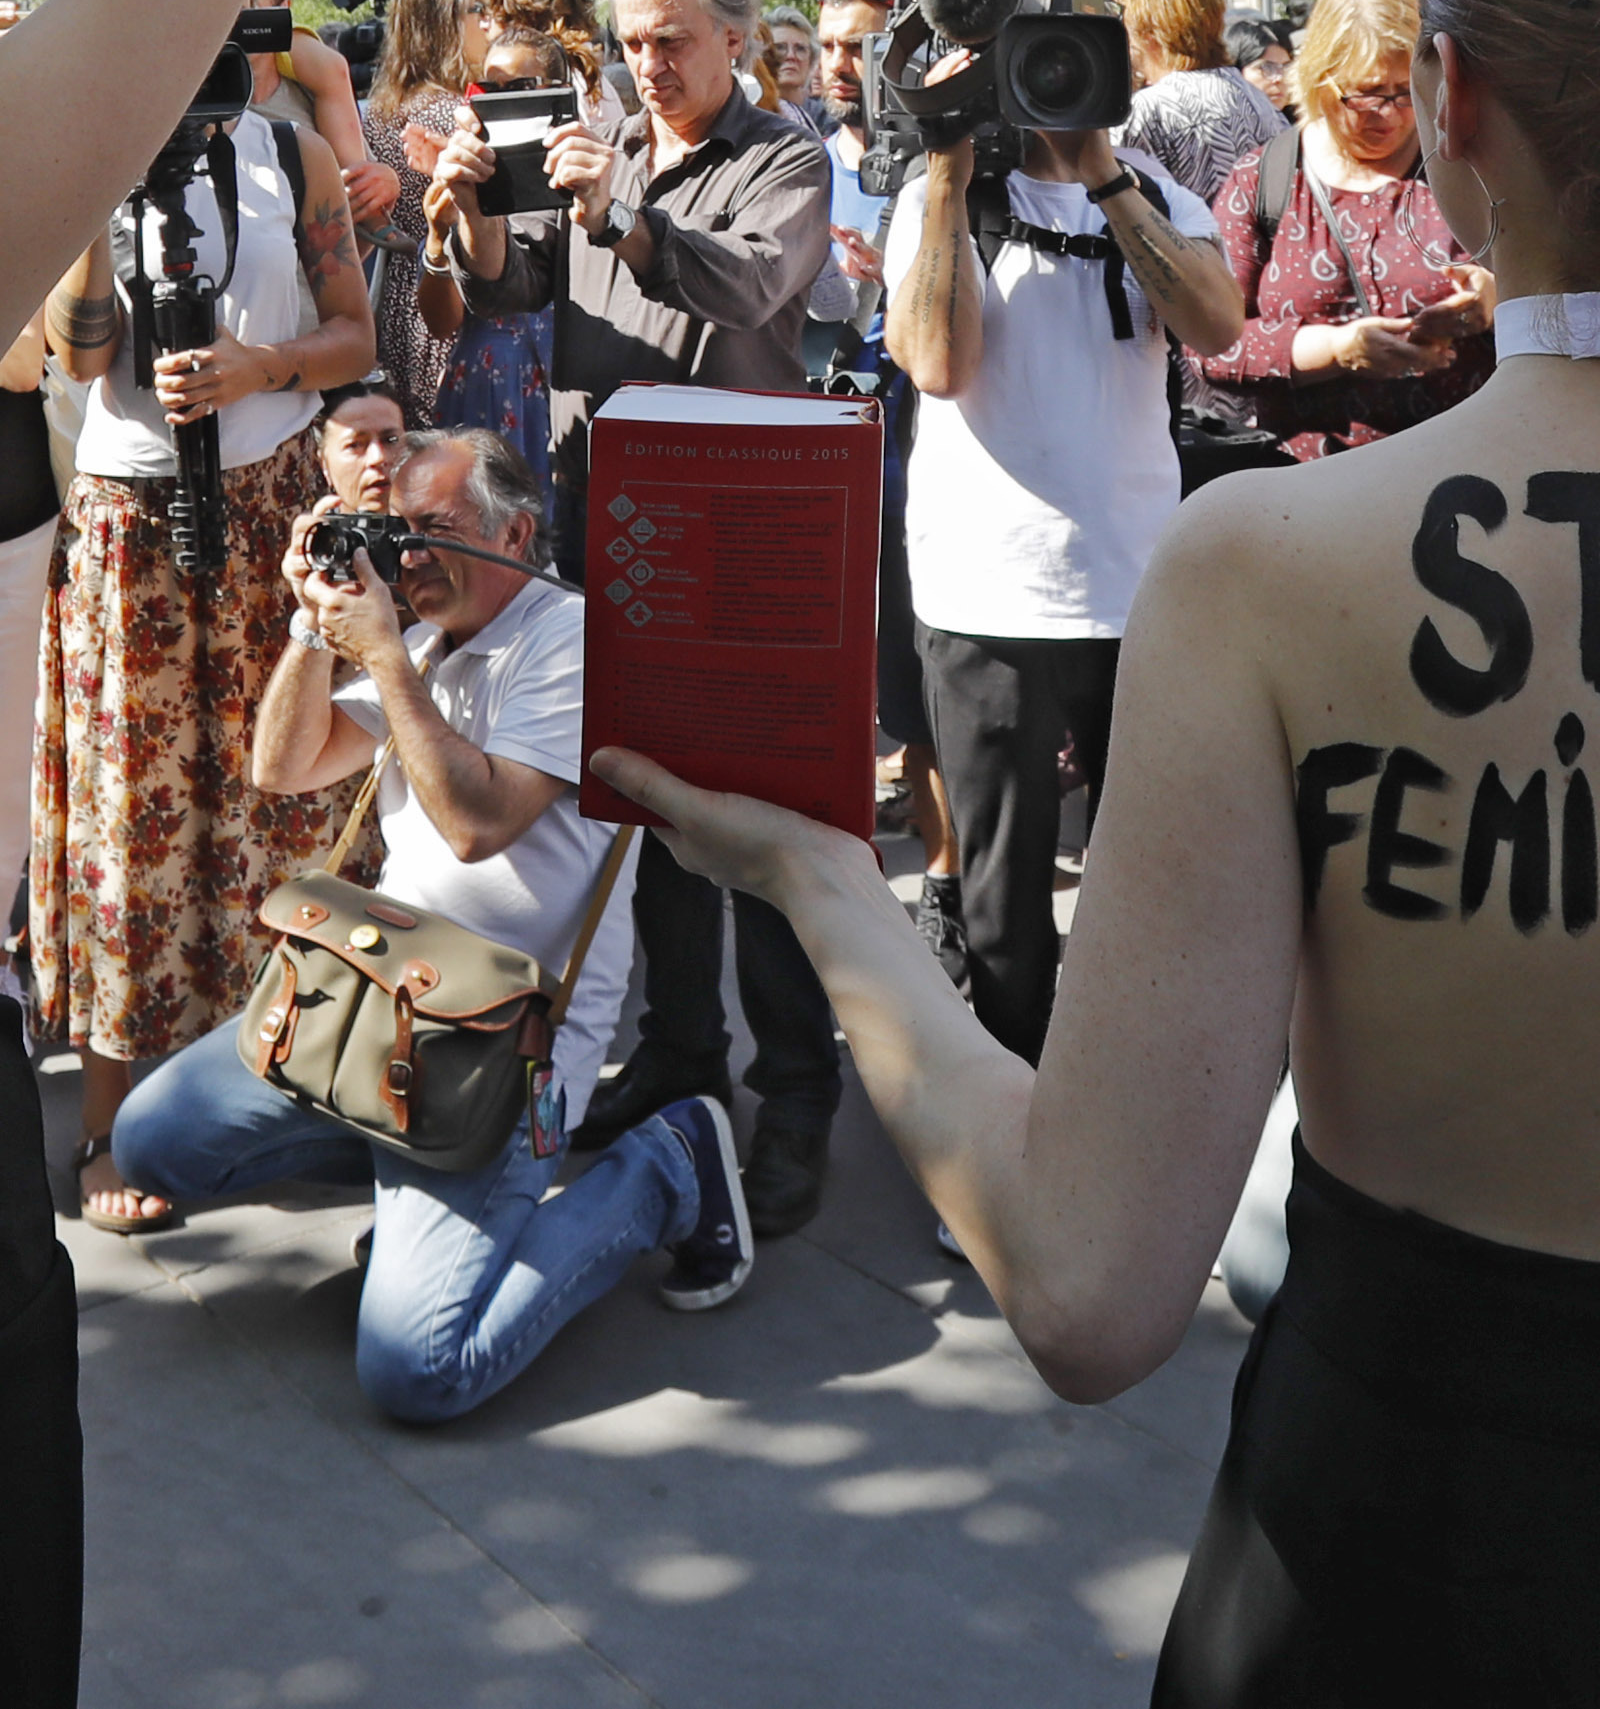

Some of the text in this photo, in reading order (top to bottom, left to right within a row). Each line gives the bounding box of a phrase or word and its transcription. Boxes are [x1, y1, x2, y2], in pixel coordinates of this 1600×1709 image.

[625, 443, 849, 461] ÉDITION CLASSIQUE 2015
